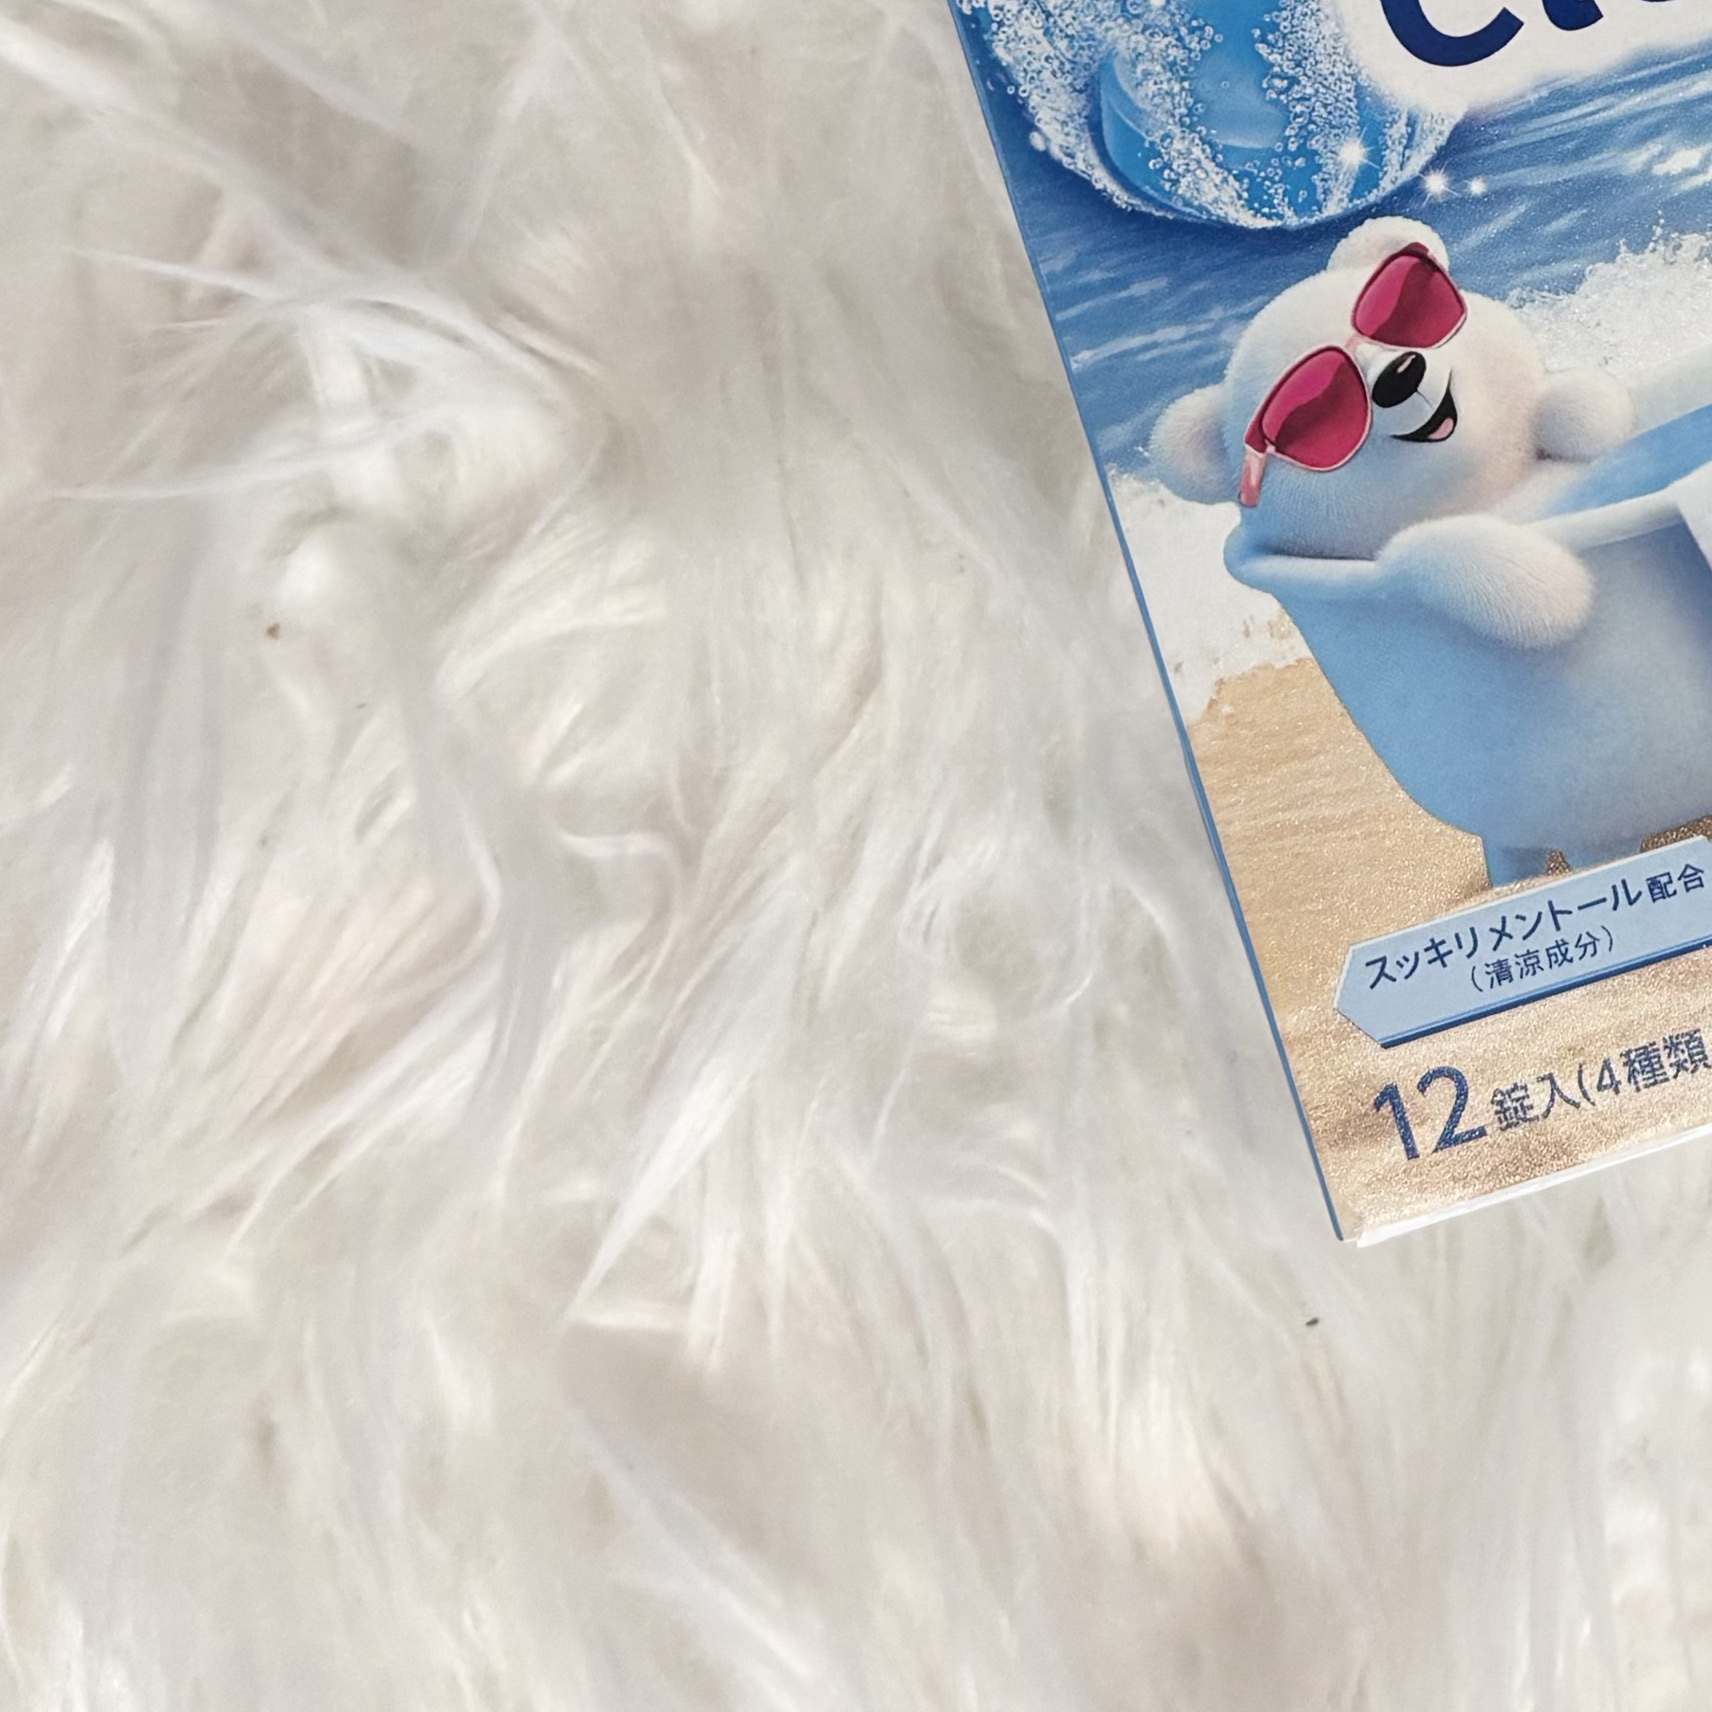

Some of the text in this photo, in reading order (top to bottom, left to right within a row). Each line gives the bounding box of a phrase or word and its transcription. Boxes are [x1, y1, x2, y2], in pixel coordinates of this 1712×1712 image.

[1365, 863, 1705, 989] スッキリメントール配合
[1470, 925, 1614, 992] (清涼成分)
